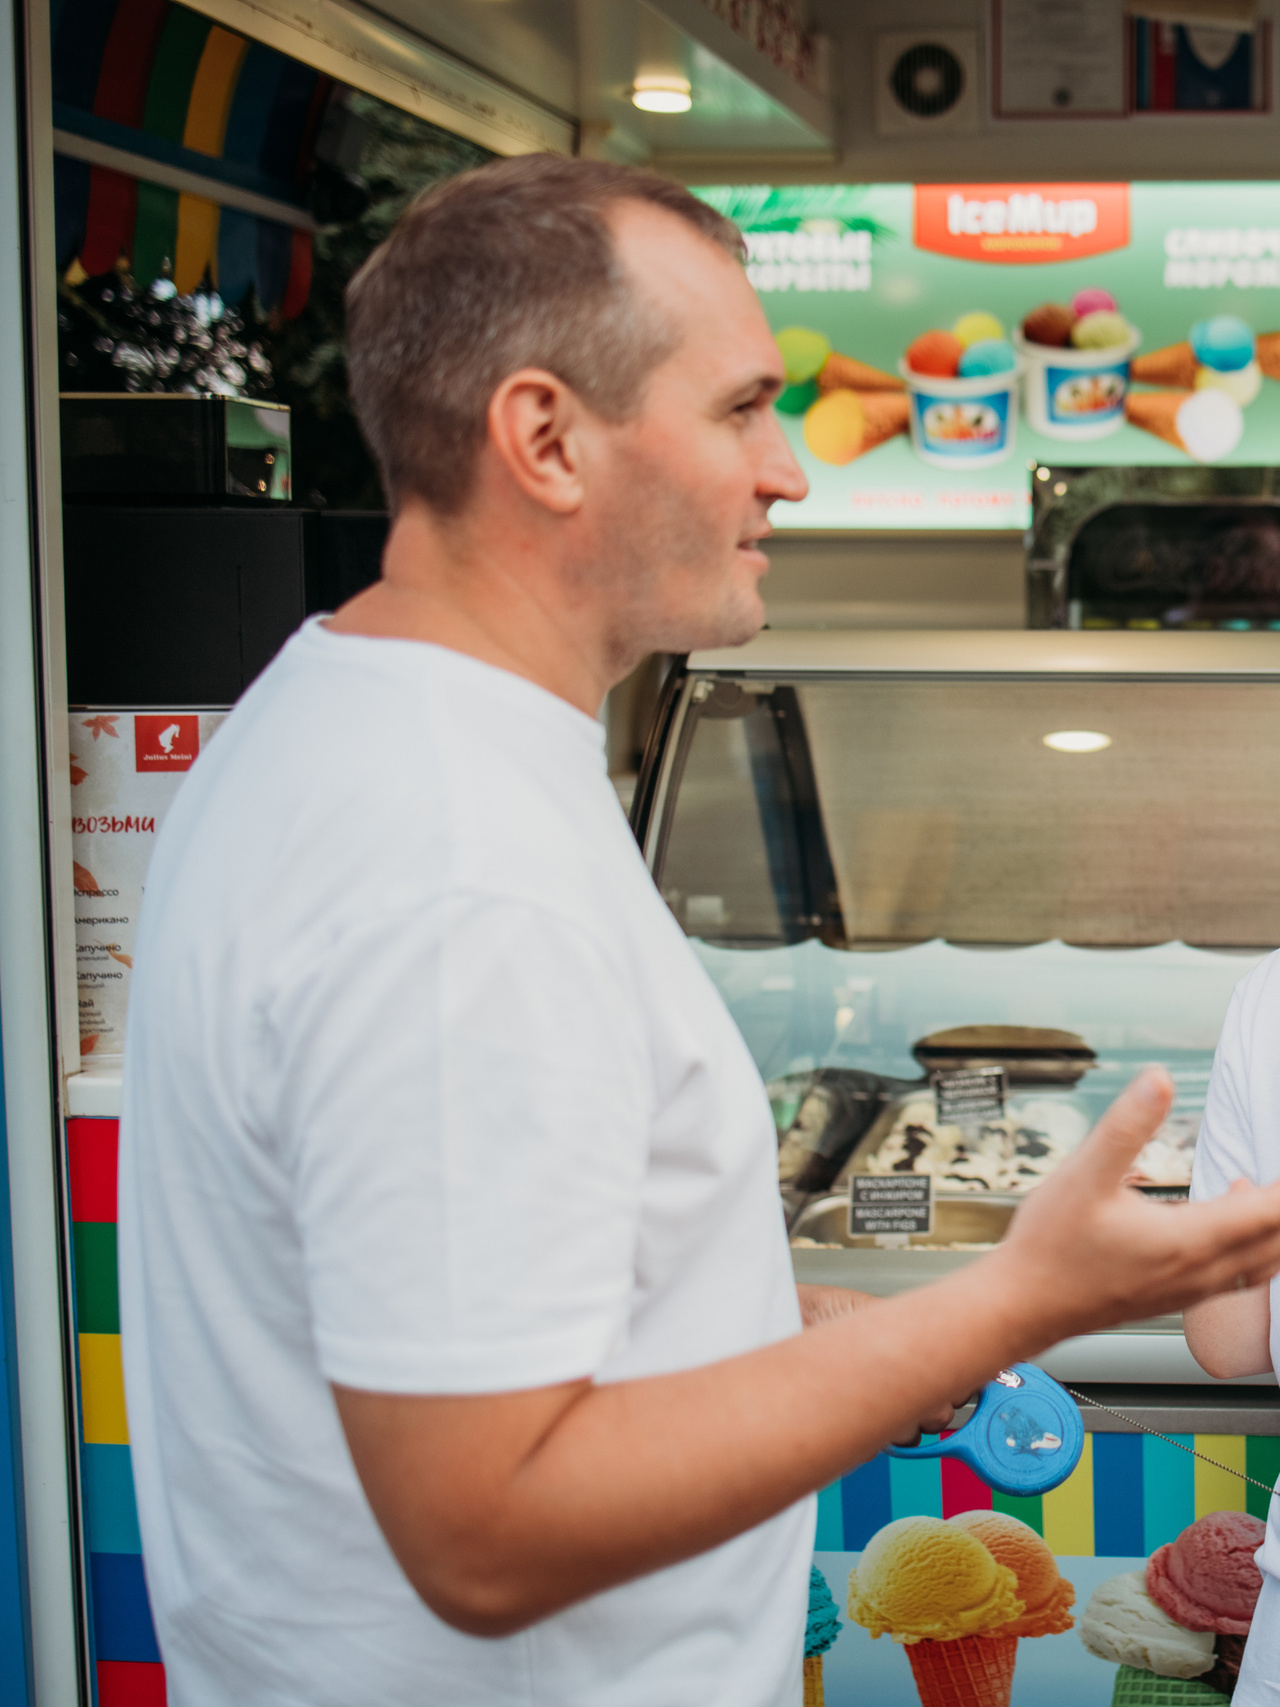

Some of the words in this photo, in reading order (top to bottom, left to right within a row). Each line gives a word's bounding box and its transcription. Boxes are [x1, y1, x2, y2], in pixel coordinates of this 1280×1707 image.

[143, 753, 168, 761] Julius
[170, 753, 192, 761] Meinl
[856, 1178, 927, 1189] МАСКАРПОНЕ
[870, 1190, 924, 1201] ИНЖИРОМ
[855, 1207, 927, 1219] MASCARPONE
[864, 1220, 891, 1232] WITH
[892, 1220, 917, 1231] FIGS
